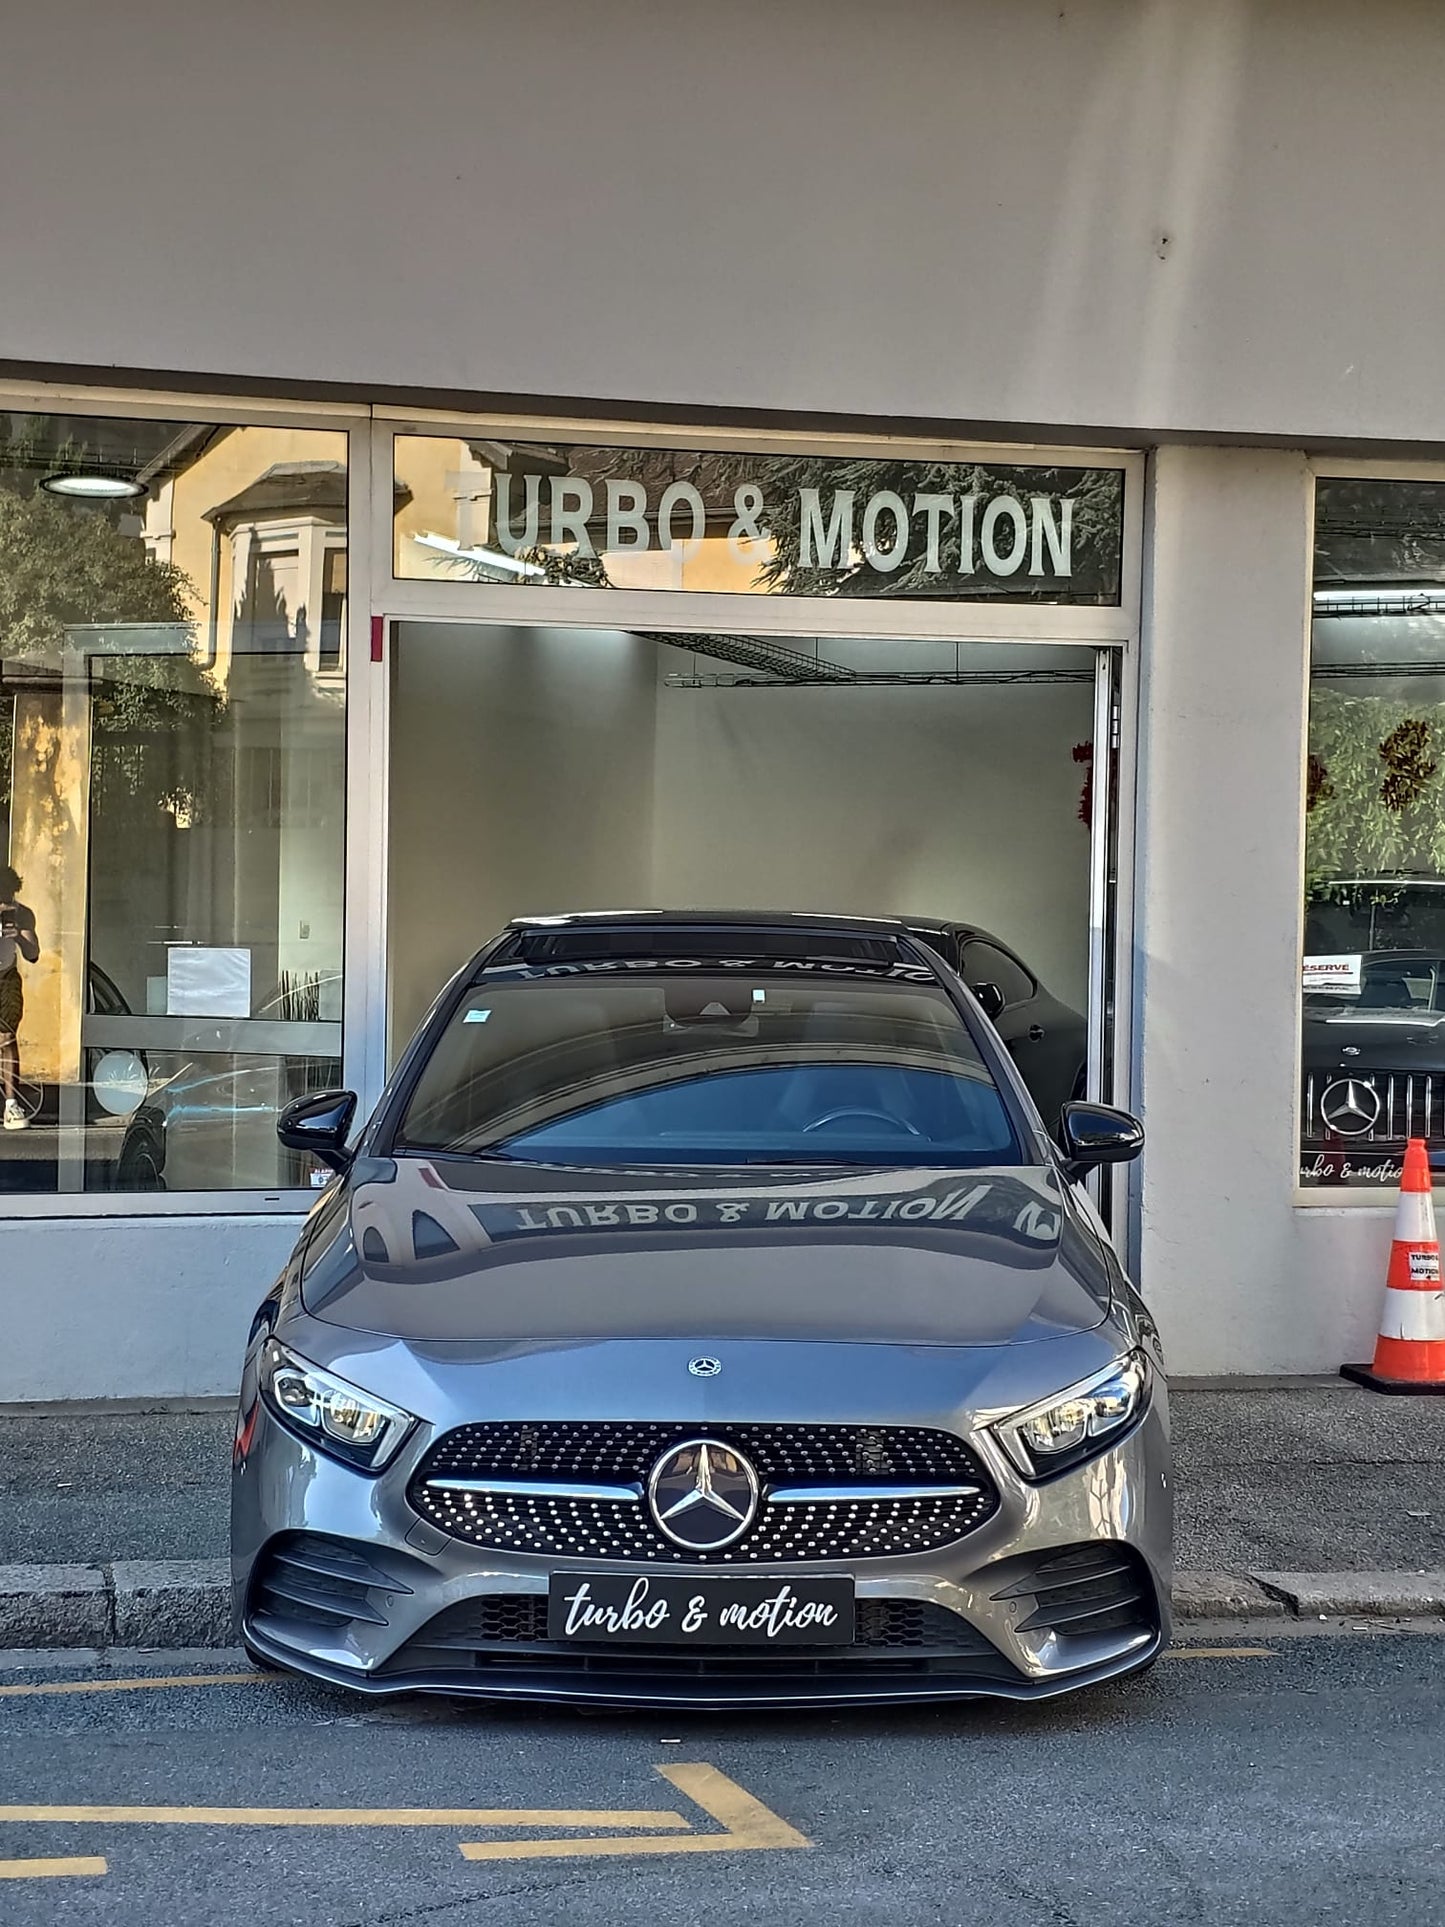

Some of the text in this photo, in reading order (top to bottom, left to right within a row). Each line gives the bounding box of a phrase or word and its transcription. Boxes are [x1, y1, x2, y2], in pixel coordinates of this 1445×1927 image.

[727, 484, 772, 566] &
[798, 487, 1076, 577] MOTION
[1340, 1162, 1352, 1178] &
[564, 1577, 838, 1637] turbo & motion
